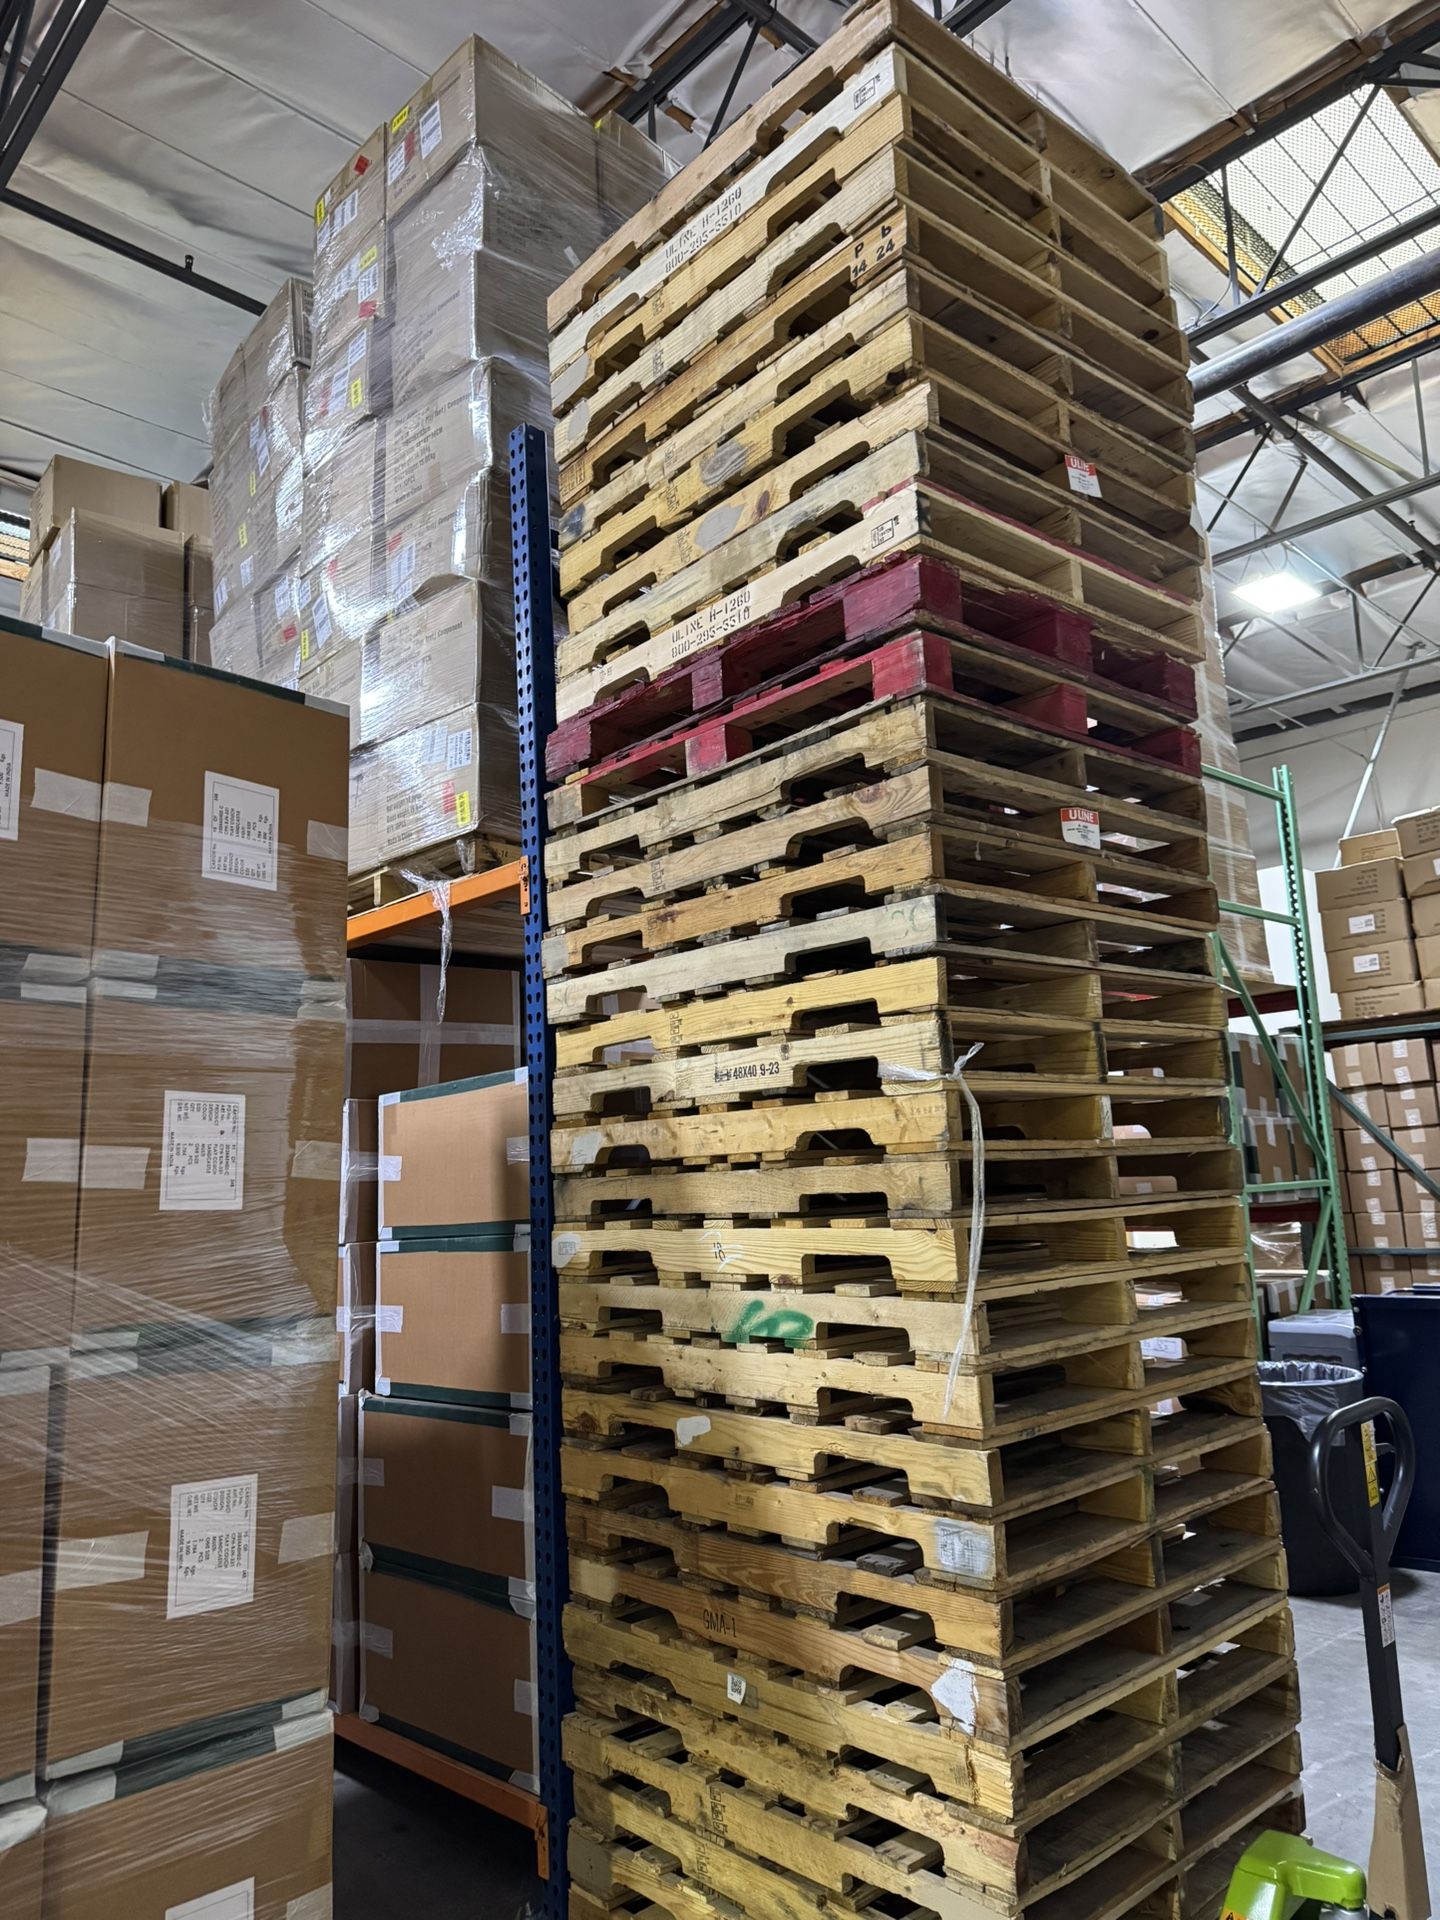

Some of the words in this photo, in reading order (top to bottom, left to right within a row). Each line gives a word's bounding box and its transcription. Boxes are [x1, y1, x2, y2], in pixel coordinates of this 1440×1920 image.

[665, 226, 697, 259] ULINE
[702, 187, 742, 228] H-1260
[665, 203, 742, 273] 800-295-5510
[855, 242, 864, 259] P
[876, 238, 895, 261] 24
[672, 616, 704, 643] ULINE
[709, 590, 751, 623] H-1260
[671, 606, 751, 658] 800-295-5510
[1068, 809, 1094, 823] ULINE
[733, 1064, 757, 1079] 48X40
[760, 1061, 780, 1076] 9-23
[703, 1608, 737, 1638] GMA-1
